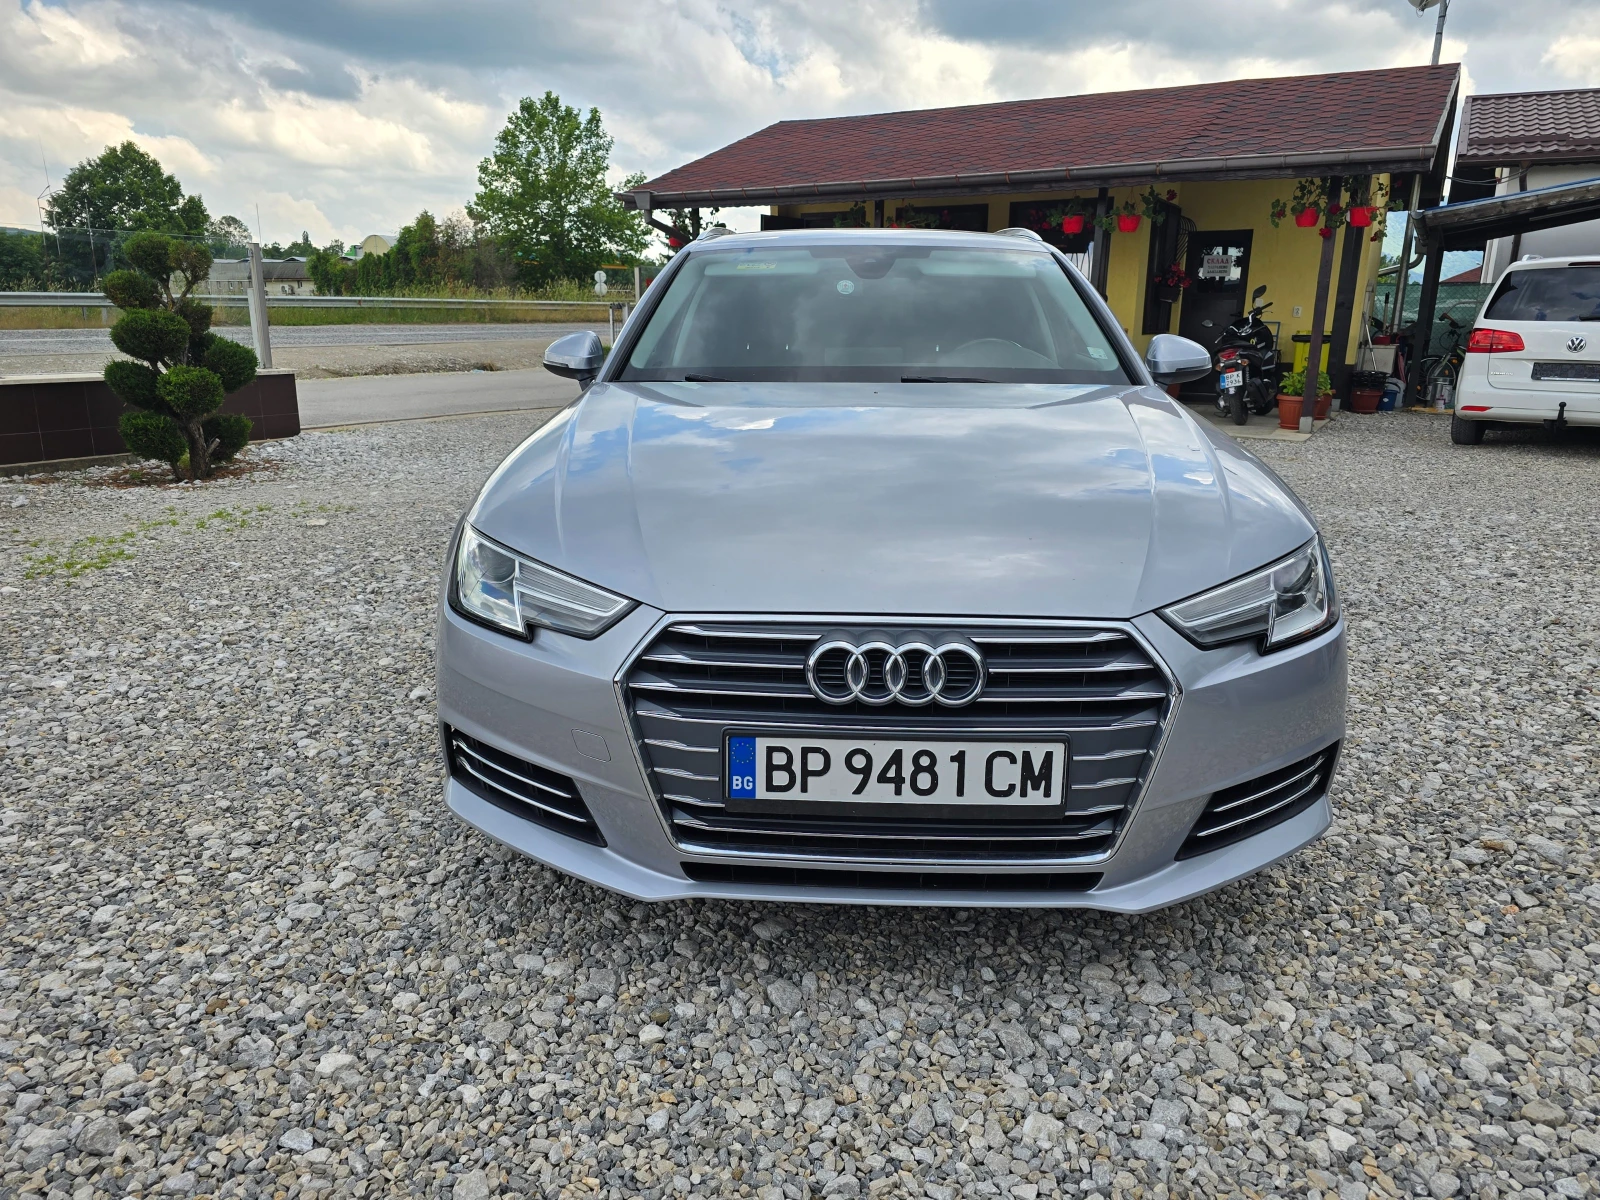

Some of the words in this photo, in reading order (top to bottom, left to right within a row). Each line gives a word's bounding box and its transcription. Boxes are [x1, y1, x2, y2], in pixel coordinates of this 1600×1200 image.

[732, 776, 754, 790] BG
[765, 746, 832, 794] BP
[844, 748, 967, 798] 9481
[984, 750, 1054, 799] CM
